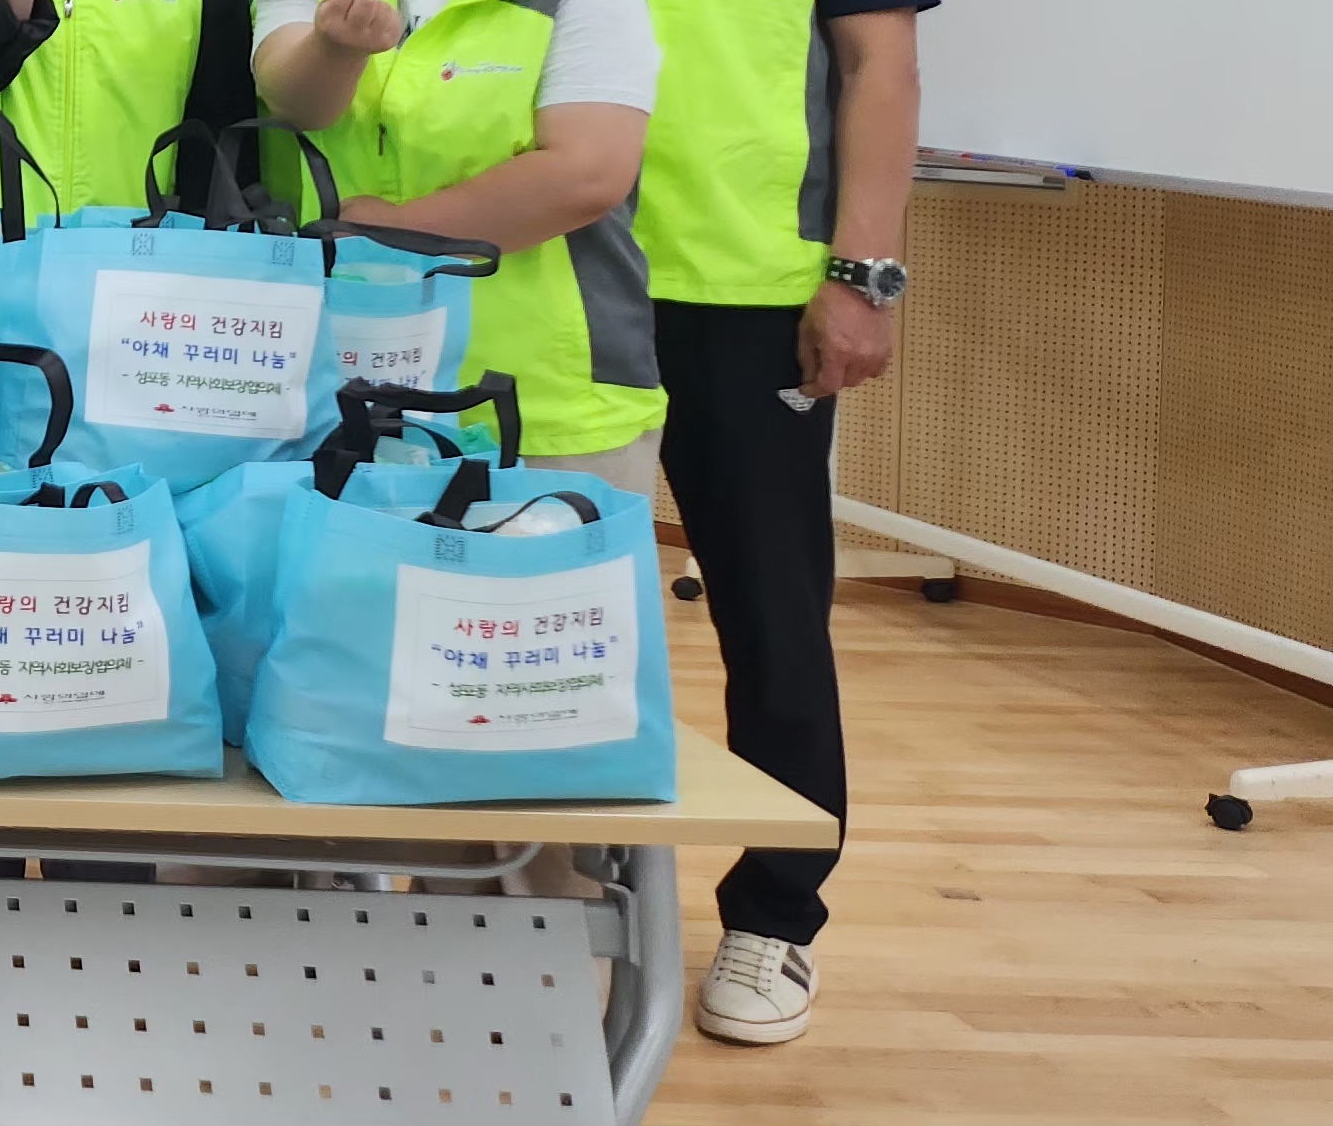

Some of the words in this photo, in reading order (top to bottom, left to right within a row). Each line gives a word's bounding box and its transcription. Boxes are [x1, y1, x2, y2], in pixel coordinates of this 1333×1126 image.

[140, 310, 197, 331] 사랑의
[211, 315, 284, 340] 건강지킴
[183, 343, 239, 365] 꾸러미
[53, 591, 130, 615] 건강지킴
[533, 606, 604, 635] 건강지킴
[23, 626, 85, 647] 꾸러미
